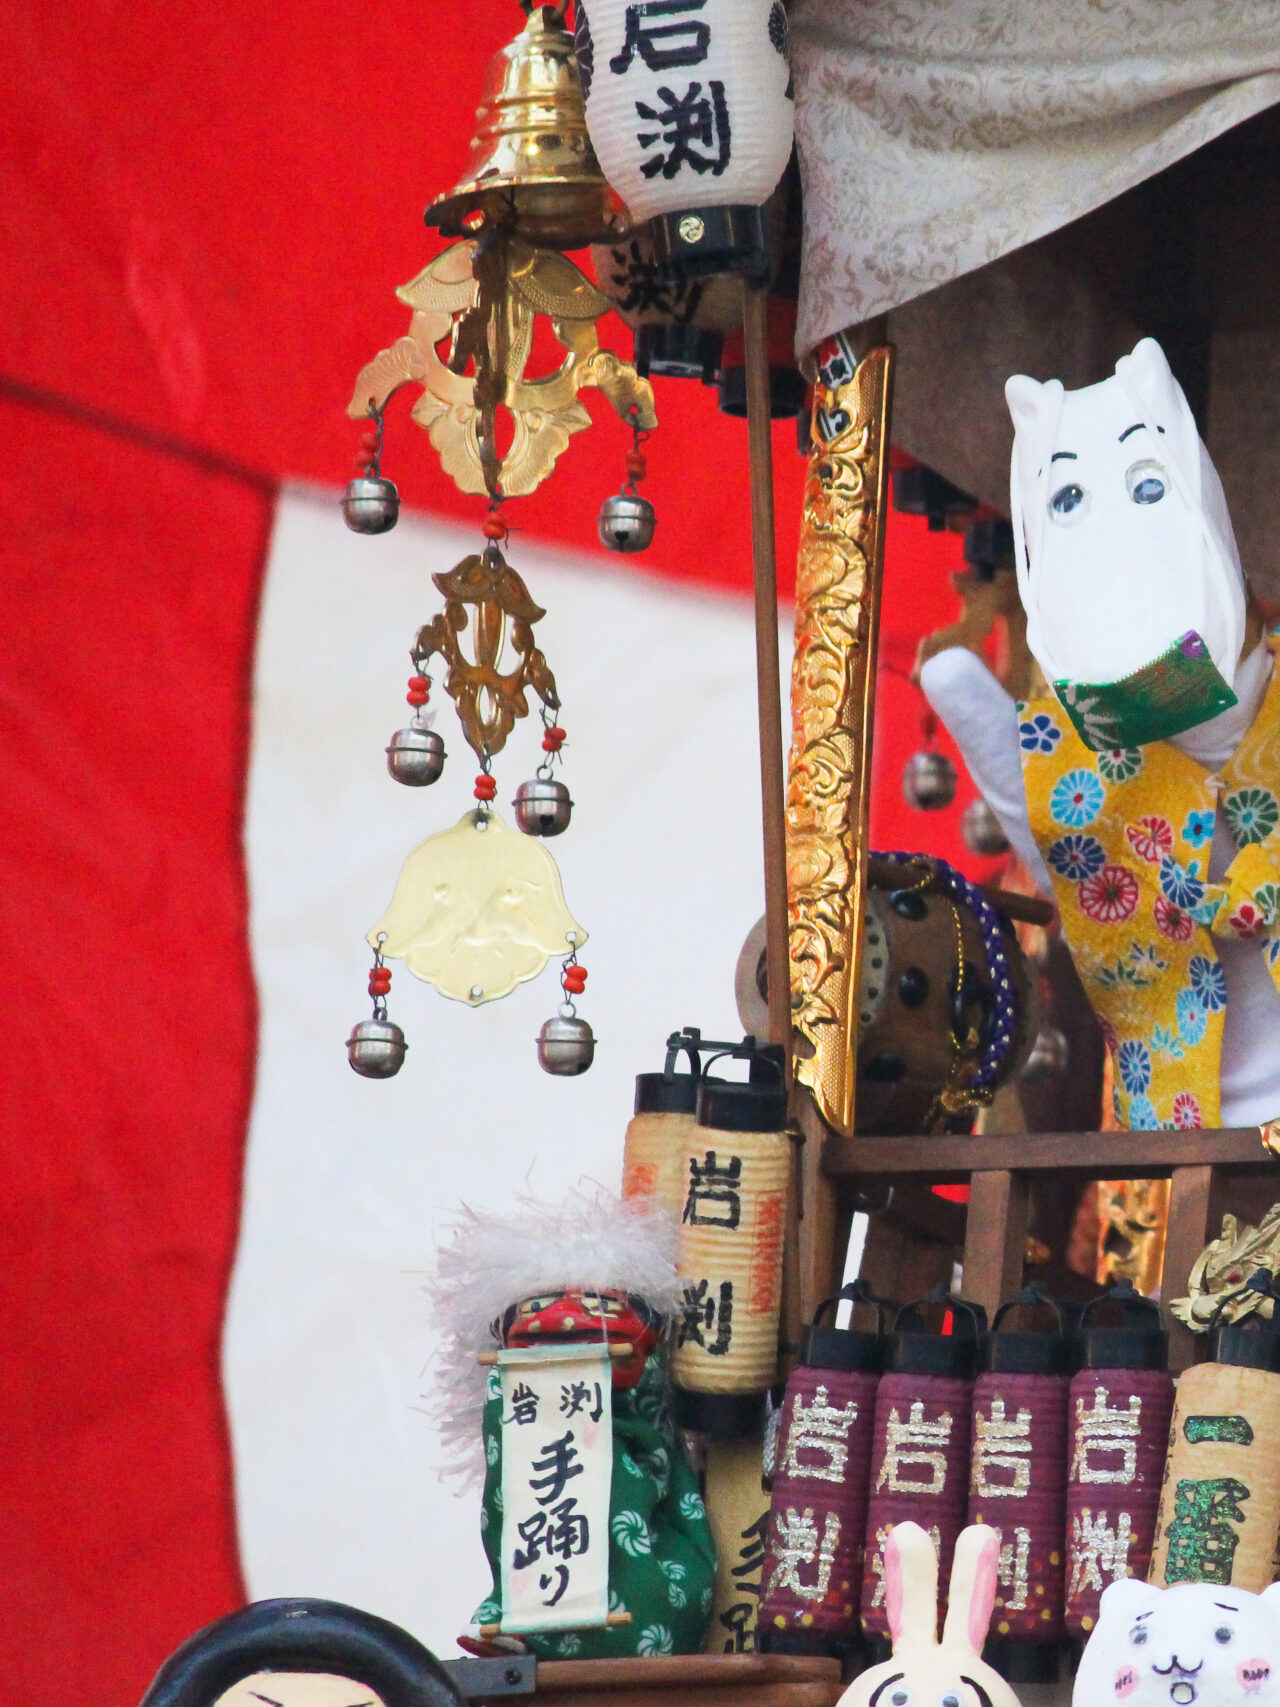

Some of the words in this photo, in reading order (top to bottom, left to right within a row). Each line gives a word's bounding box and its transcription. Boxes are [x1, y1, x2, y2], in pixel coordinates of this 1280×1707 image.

[500, 1381, 603, 1424] 岩渕
[513, 1430, 589, 1607] 手踊り
[1164, 1415, 1254, 1586] 一番
